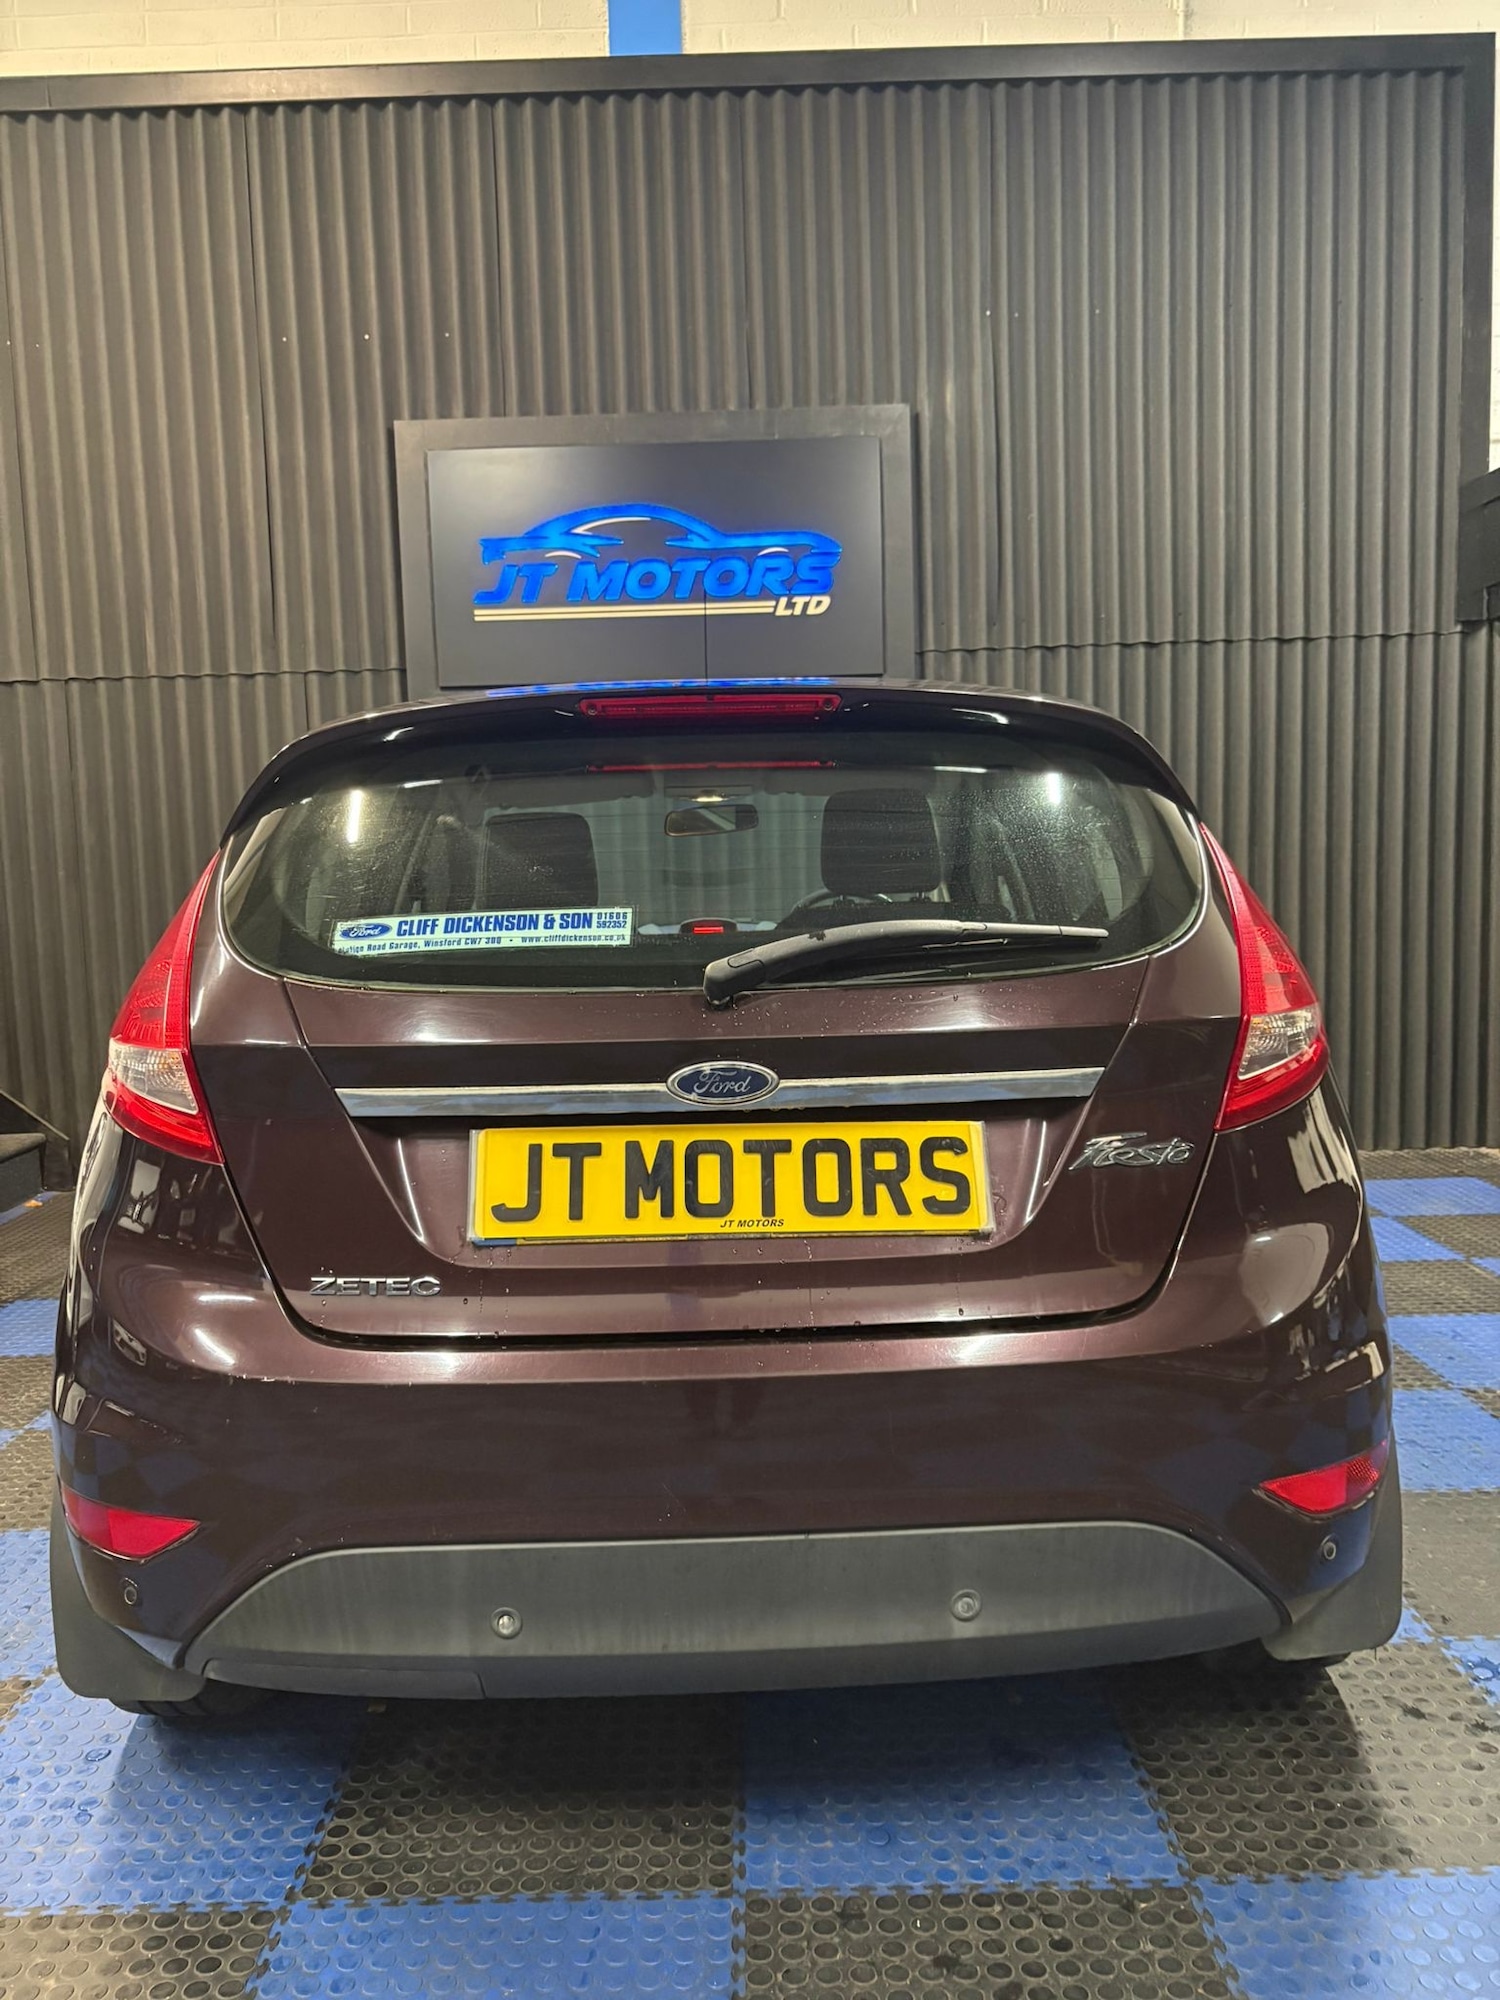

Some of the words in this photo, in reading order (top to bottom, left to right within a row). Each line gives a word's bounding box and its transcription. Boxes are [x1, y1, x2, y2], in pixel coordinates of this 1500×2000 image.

[474, 562, 559, 604] JT
[566, 552, 841, 602] MOTORS
[774, 596, 832, 617] LTD
[396, 918, 440, 937] CLIFF
[443, 913, 540, 934] DICKENSON
[543, 913, 556, 930] &
[558, 912, 593, 930] SON
[596, 911, 628, 920] 01606
[596, 920, 627, 929] 592352
[349, 924, 383, 938] Ford
[366, 942, 387, 952] Road
[389, 940, 421, 951] Garage,
[424, 937, 462, 948] Winsford
[464, 937, 482, 945] CW7
[521, 934, 626, 944] www.cliffdickenson.co.uk
[693, 1069, 752, 1094] Ford
[1068, 1132, 1195, 1171] Fiesta
[490, 1141, 602, 1223] JT
[624, 1136, 971, 1219] MOTORS
[720, 1219, 735, 1228] JT
[737, 1218, 785, 1228] MOTORS
[310, 1275, 442, 1297] ZETEC
